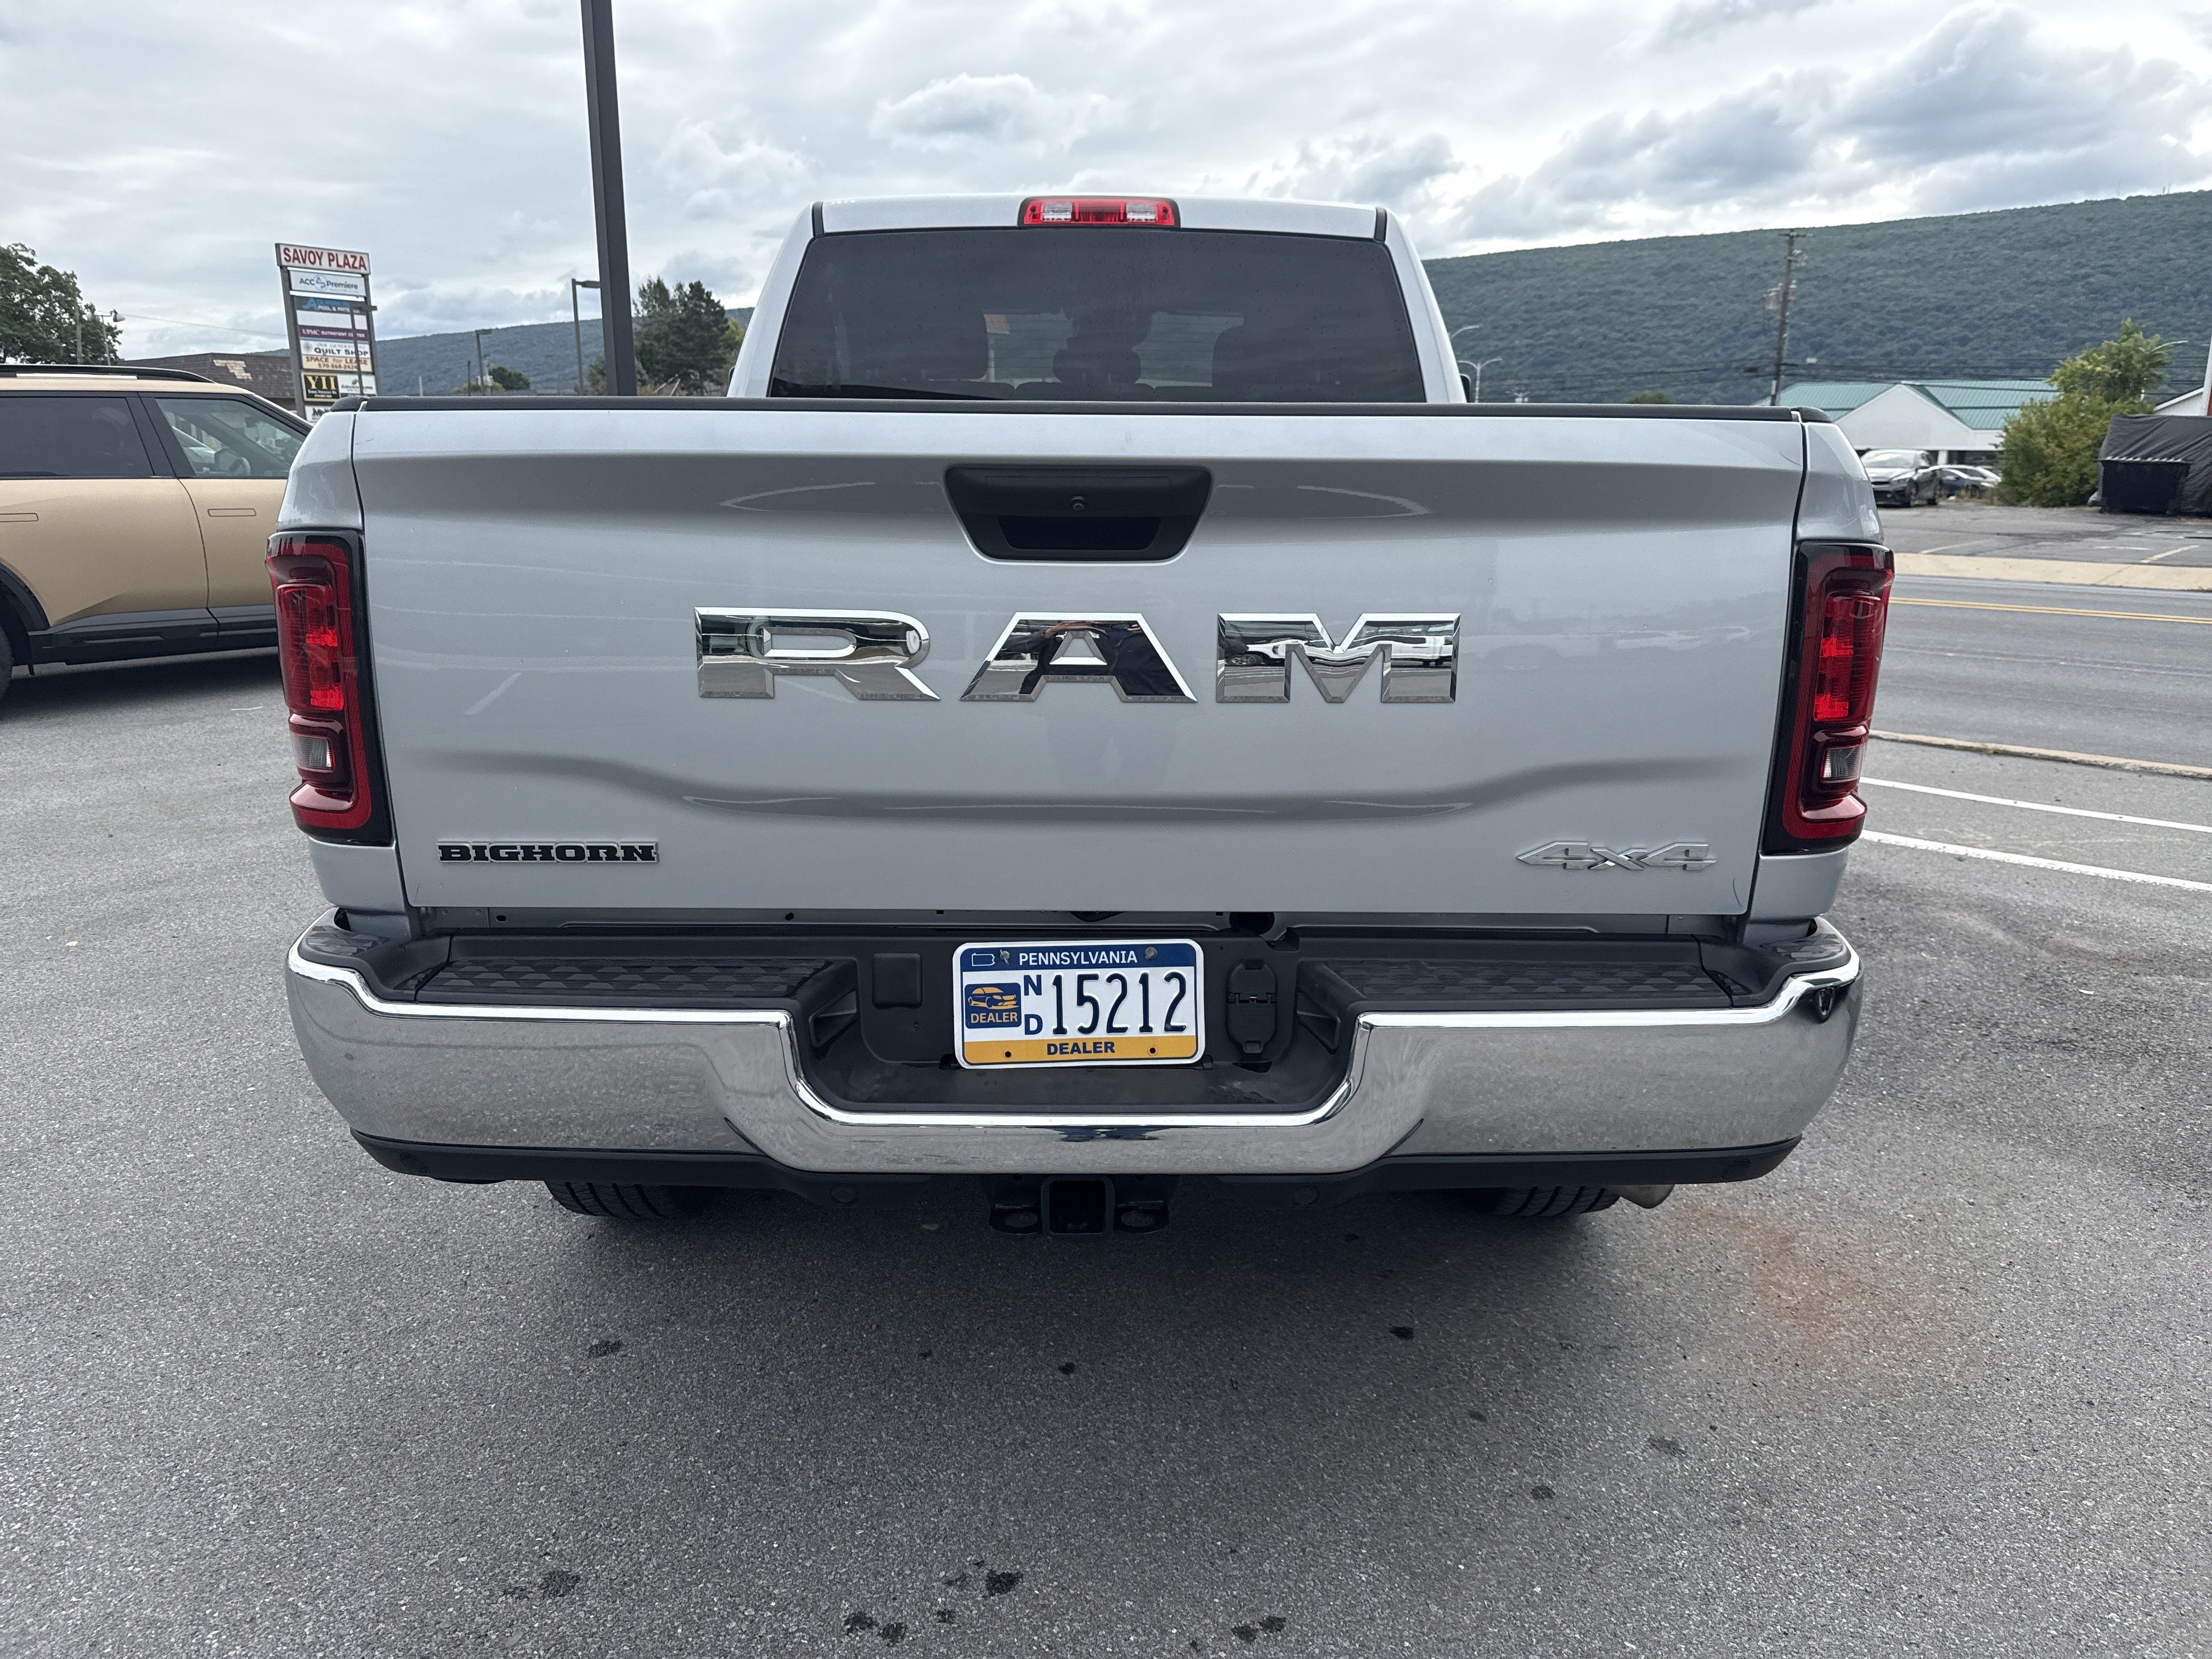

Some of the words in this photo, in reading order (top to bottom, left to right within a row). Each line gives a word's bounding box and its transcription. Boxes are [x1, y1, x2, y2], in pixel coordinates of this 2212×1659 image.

[283, 247, 323, 266] SAVOY
[328, 252, 367, 270] PLAZA
[326, 280, 358, 289] Premiere
[306, 375, 337, 390] YII
[695, 606, 1460, 704] RAM
[436, 843, 658, 863] BIGHORN
[1019, 950, 1138, 966] PENNSYLVANIA
[1052, 972, 1187, 1035] 15212
[970, 1012, 1018, 1023] DEALER
[1047, 1041, 1115, 1056] DEALER
